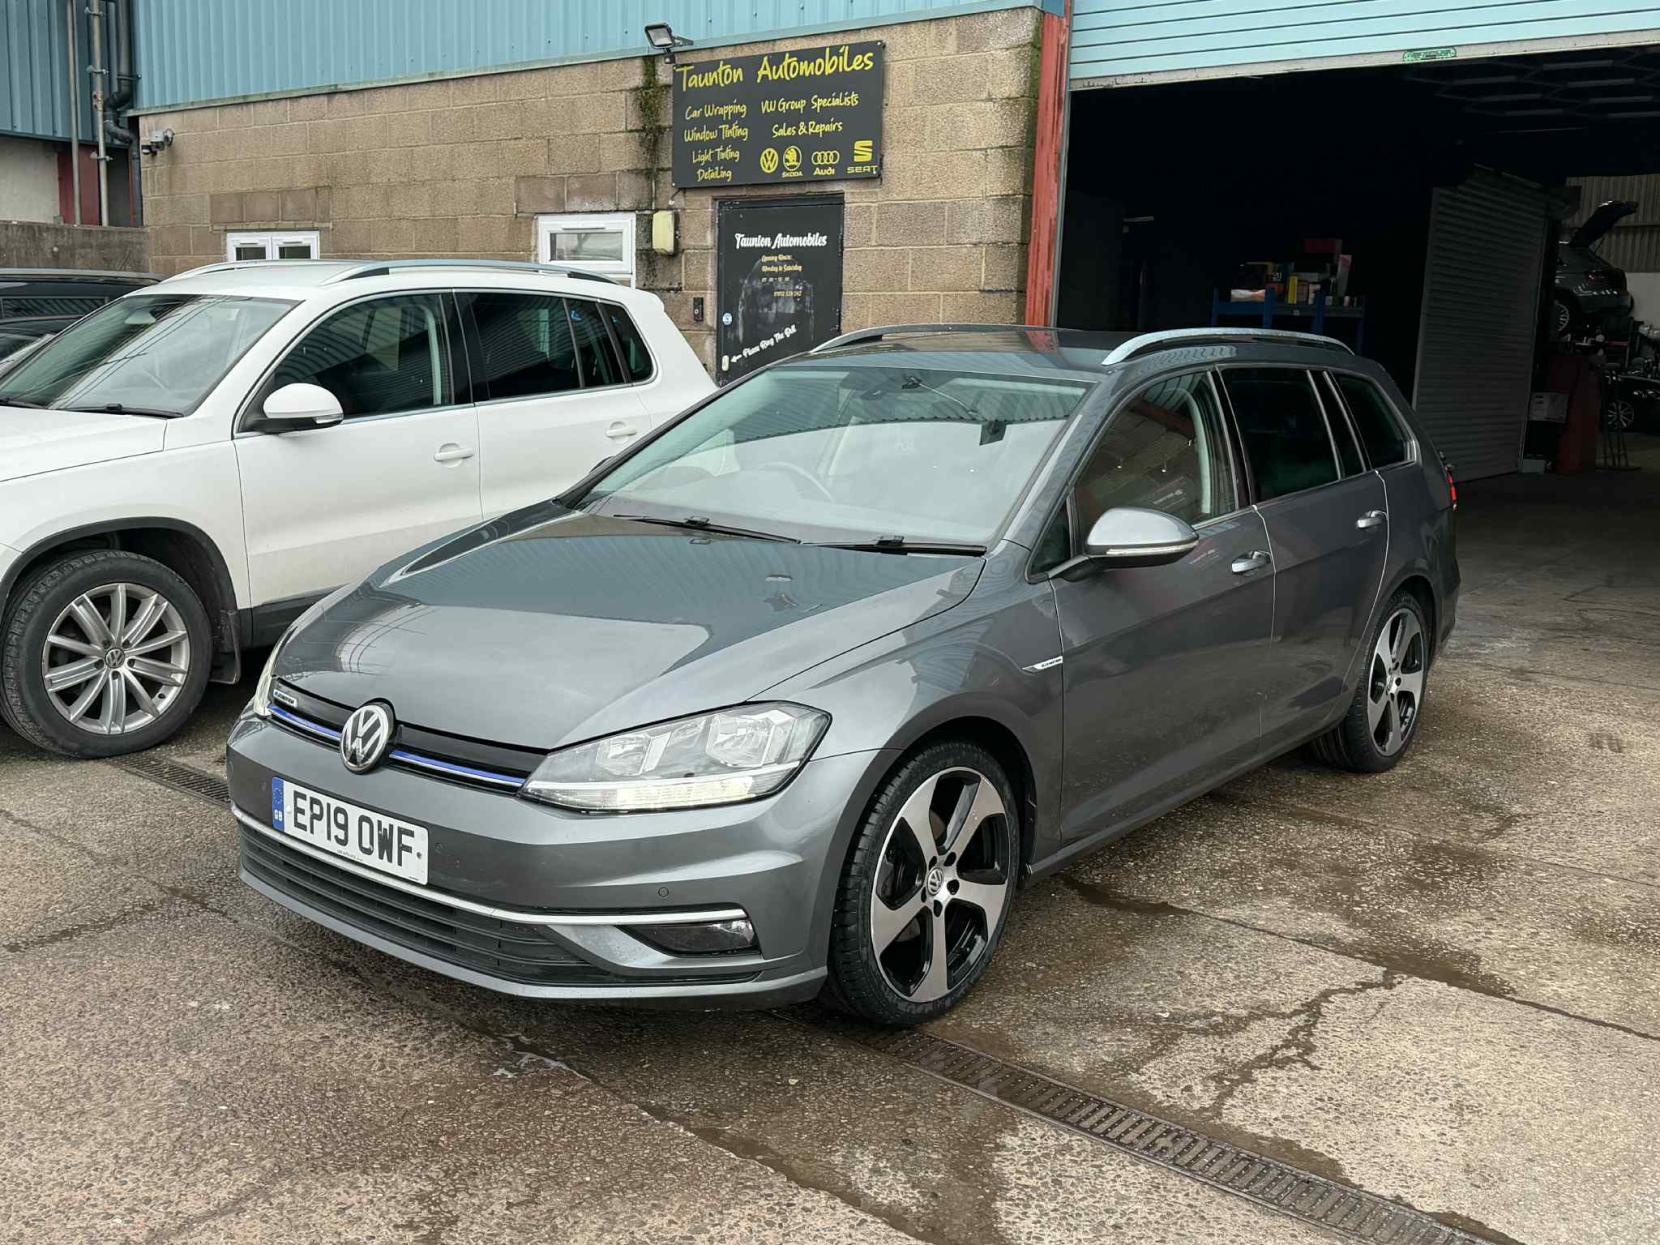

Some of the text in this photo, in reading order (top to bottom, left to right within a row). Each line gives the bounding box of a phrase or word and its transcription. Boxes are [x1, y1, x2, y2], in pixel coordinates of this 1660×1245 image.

[676, 46, 874, 91] Taunton Automobiles
[685, 99, 747, 120] Car Wrapping
[778, 98, 806, 113] Group
[811, 91, 859, 113] Specialists
[684, 120, 748, 142] Window Tinting
[772, 118, 843, 138] Sales & Repairs
[692, 145, 740, 166] Light Tinting
[697, 166, 732, 182] Detailing
[813, 167, 835, 176] Audi
[847, 165, 878, 174] SEAT
[734, 232, 827, 249] Taunton Automobiles
[293, 790, 415, 867] EP19 OWF
